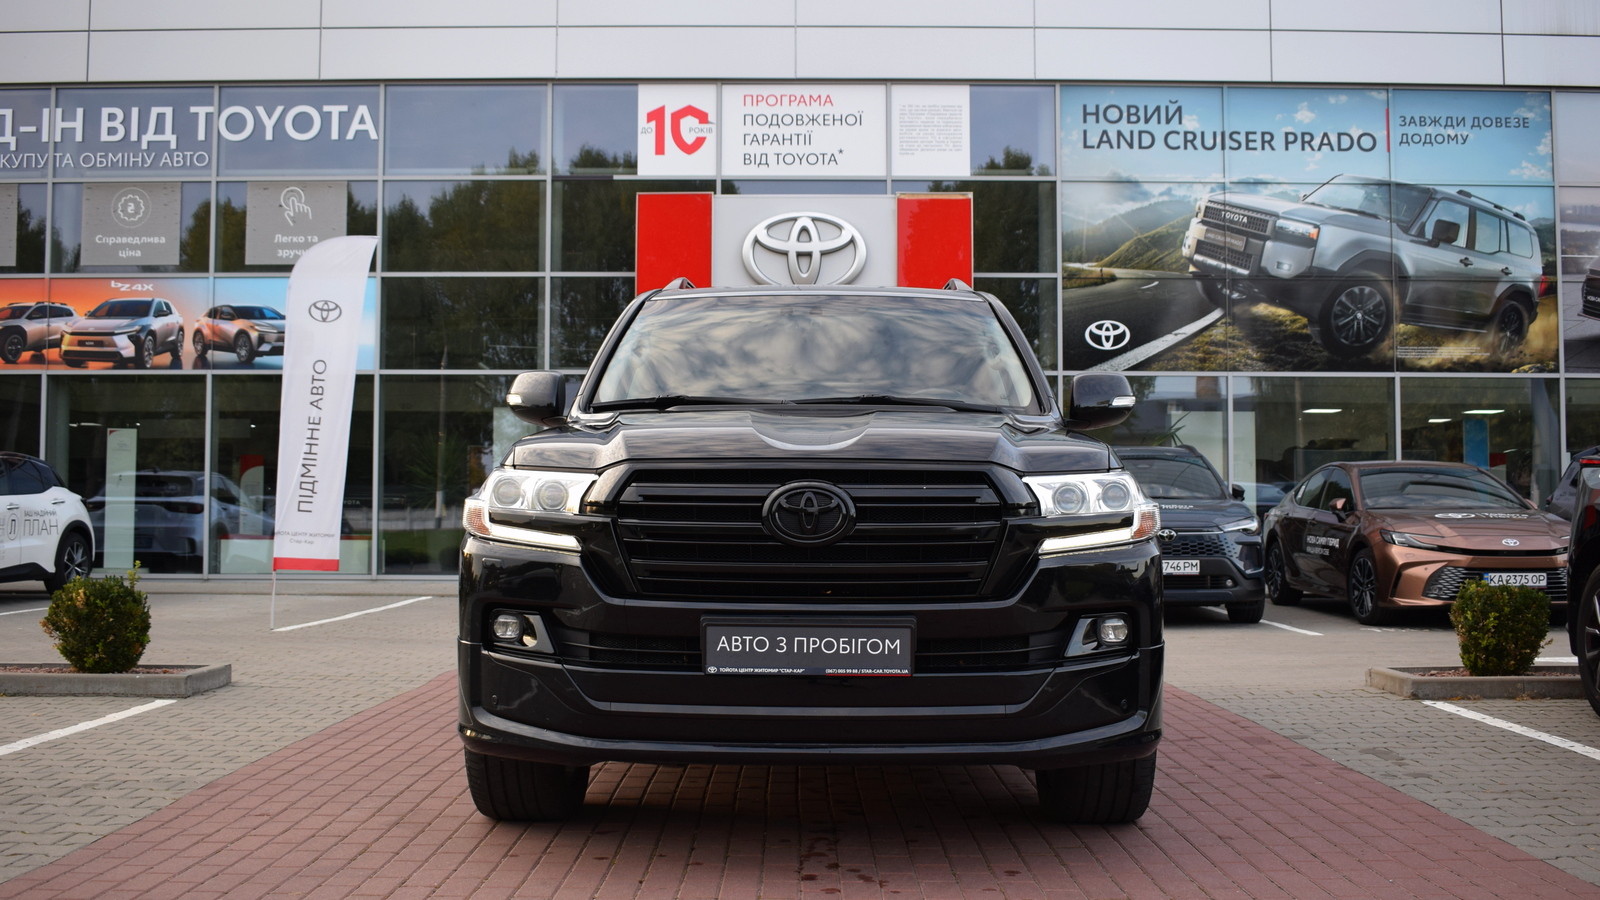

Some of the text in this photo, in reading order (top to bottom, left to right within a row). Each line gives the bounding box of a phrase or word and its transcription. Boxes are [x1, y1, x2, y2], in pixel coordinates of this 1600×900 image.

[743, 94, 834, 107] ПРОГРАМА
[743, 110, 864, 129] ПОДОВЖЕНОЇ
[1082, 99, 1183, 125] НОВИЙ
[100, 107, 177, 149] ВІД
[190, 105, 379, 141] TOYOTA
[646, 104, 709, 155] 10
[1399, 115, 1530, 130] ЗАВЖДИ ДОВЕЗЕ
[743, 130, 813, 146] ГАРАНТІЇ
[1082, 129, 1377, 152] LAND CRUISER PRADO
[1399, 133, 1469, 147] ДОДОМУ
[0, 151, 209, 168] КУПУ ТА ОБМІНУ АВТО
[743, 153, 769, 168] ВІД
[1221, 211, 1248, 223] TOYOTA
[95, 234, 166, 246] Справедлива
[274, 233, 319, 243] Легко та
[118, 247, 142, 258] ціна
[297, 359, 327, 513] ПІДМІННЕ АВТО
[23, 518, 59, 536] ПЛАН
[1183, 562, 1198, 571] PM
[1506, 574, 1530, 585] 2375
[717, 636, 770, 652] АВТО
[794, 637, 901, 655] ПРОБІГОМ
